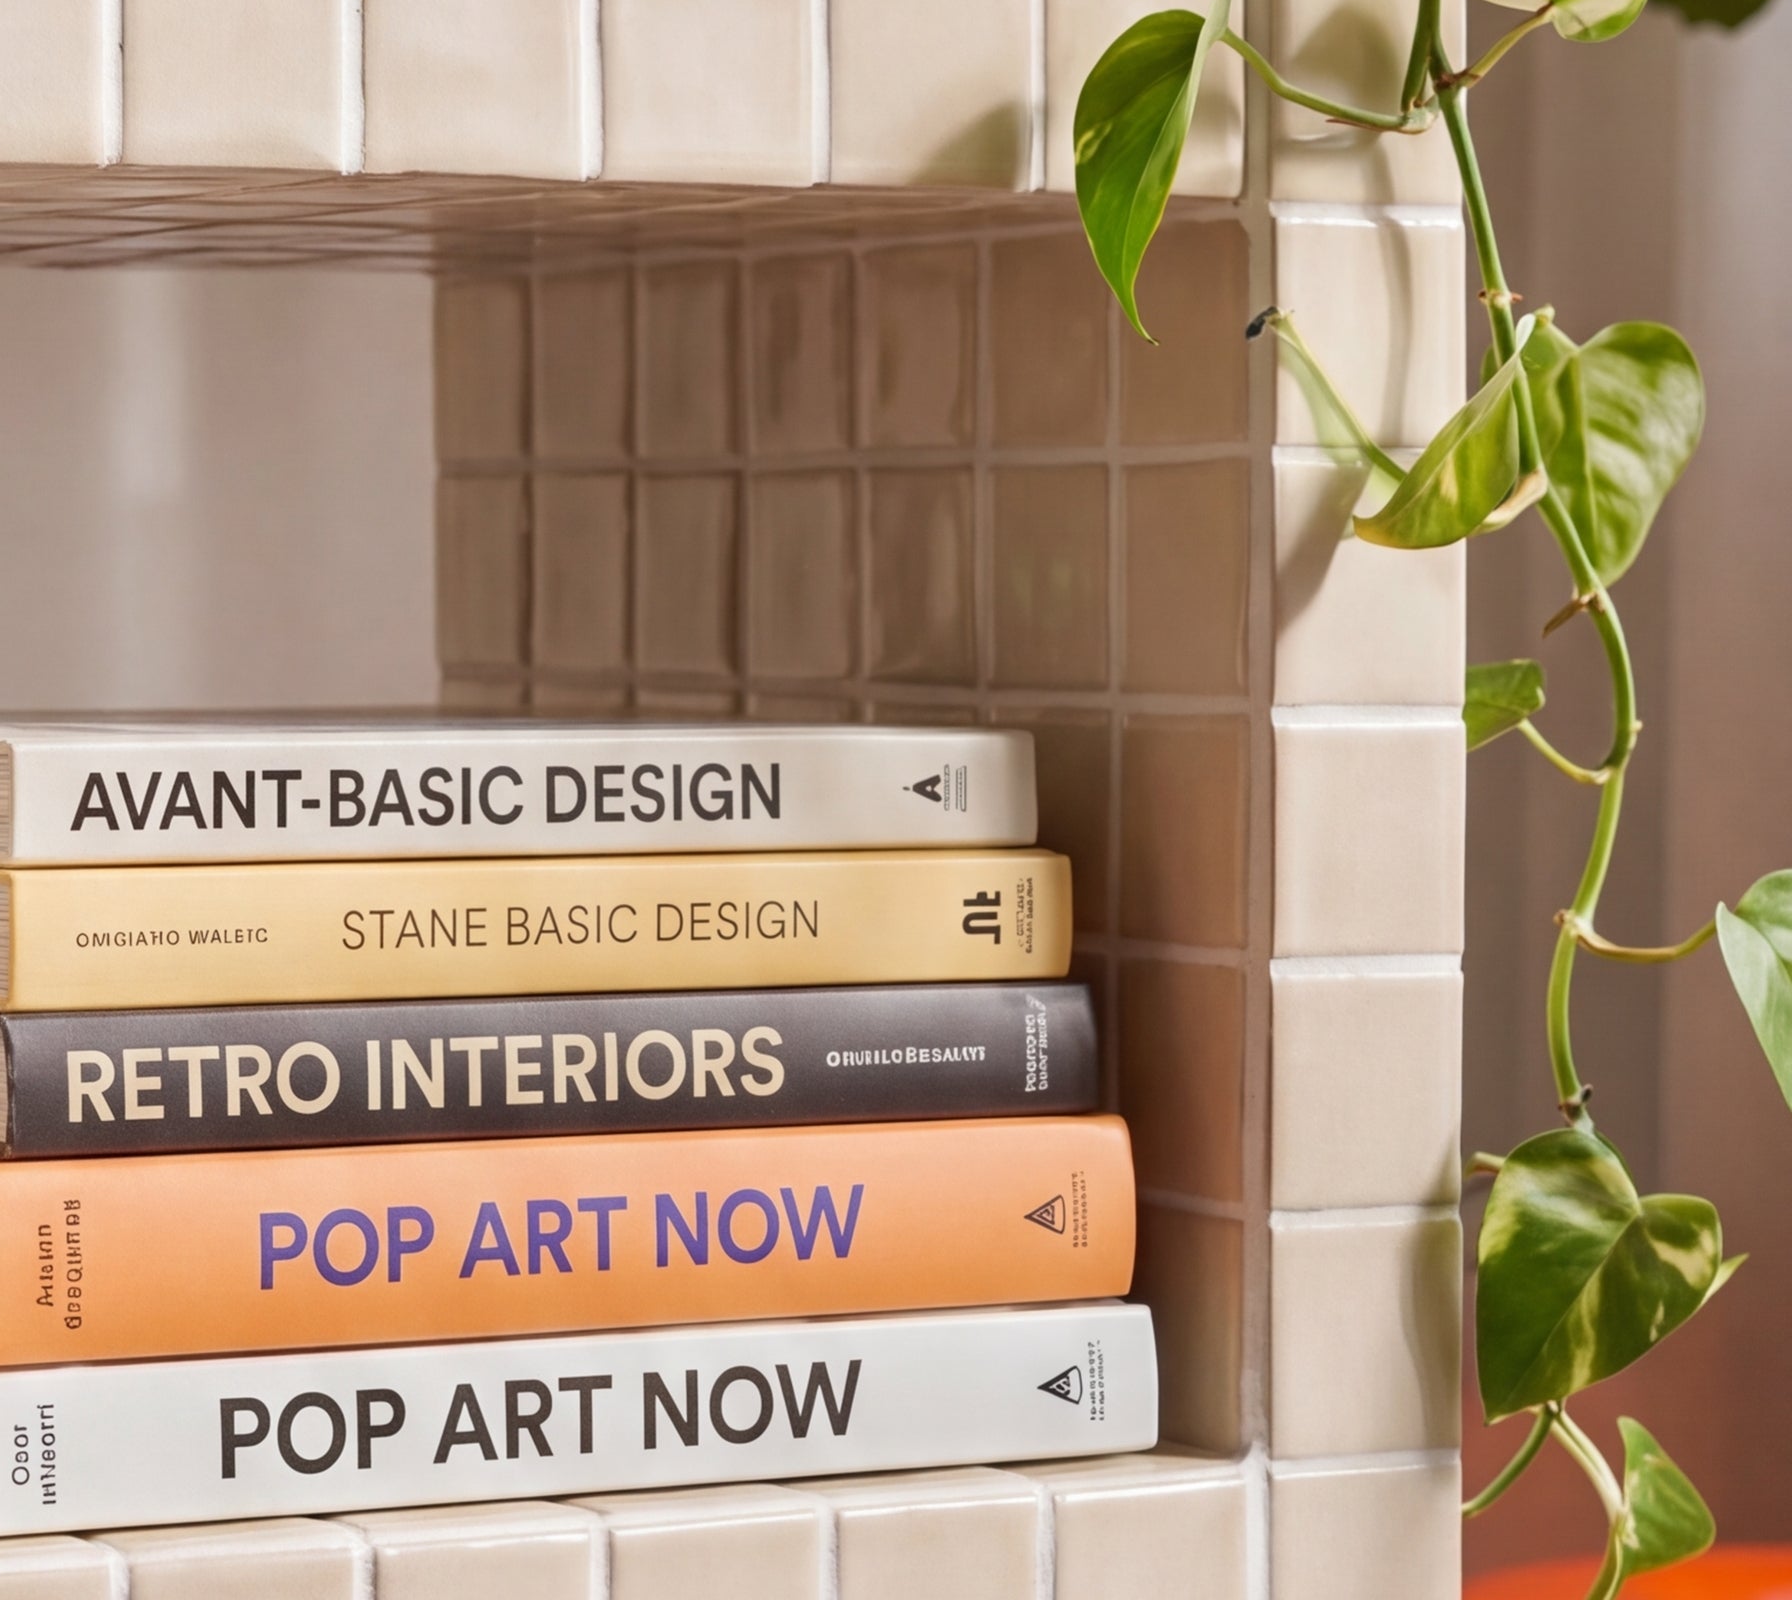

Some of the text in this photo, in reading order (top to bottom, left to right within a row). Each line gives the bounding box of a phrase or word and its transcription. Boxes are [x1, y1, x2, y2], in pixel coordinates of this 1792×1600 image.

[70, 762, 781, 832] AVANT-BASIC DESIGN
[342, 900, 820, 951] STANE BASIC DESIGN
[66, 1025, 786, 1123] RETRO INTERIORS
[259, 1184, 865, 1291] POP ART NOW
[219, 1359, 863, 1480] POP ART NOW
